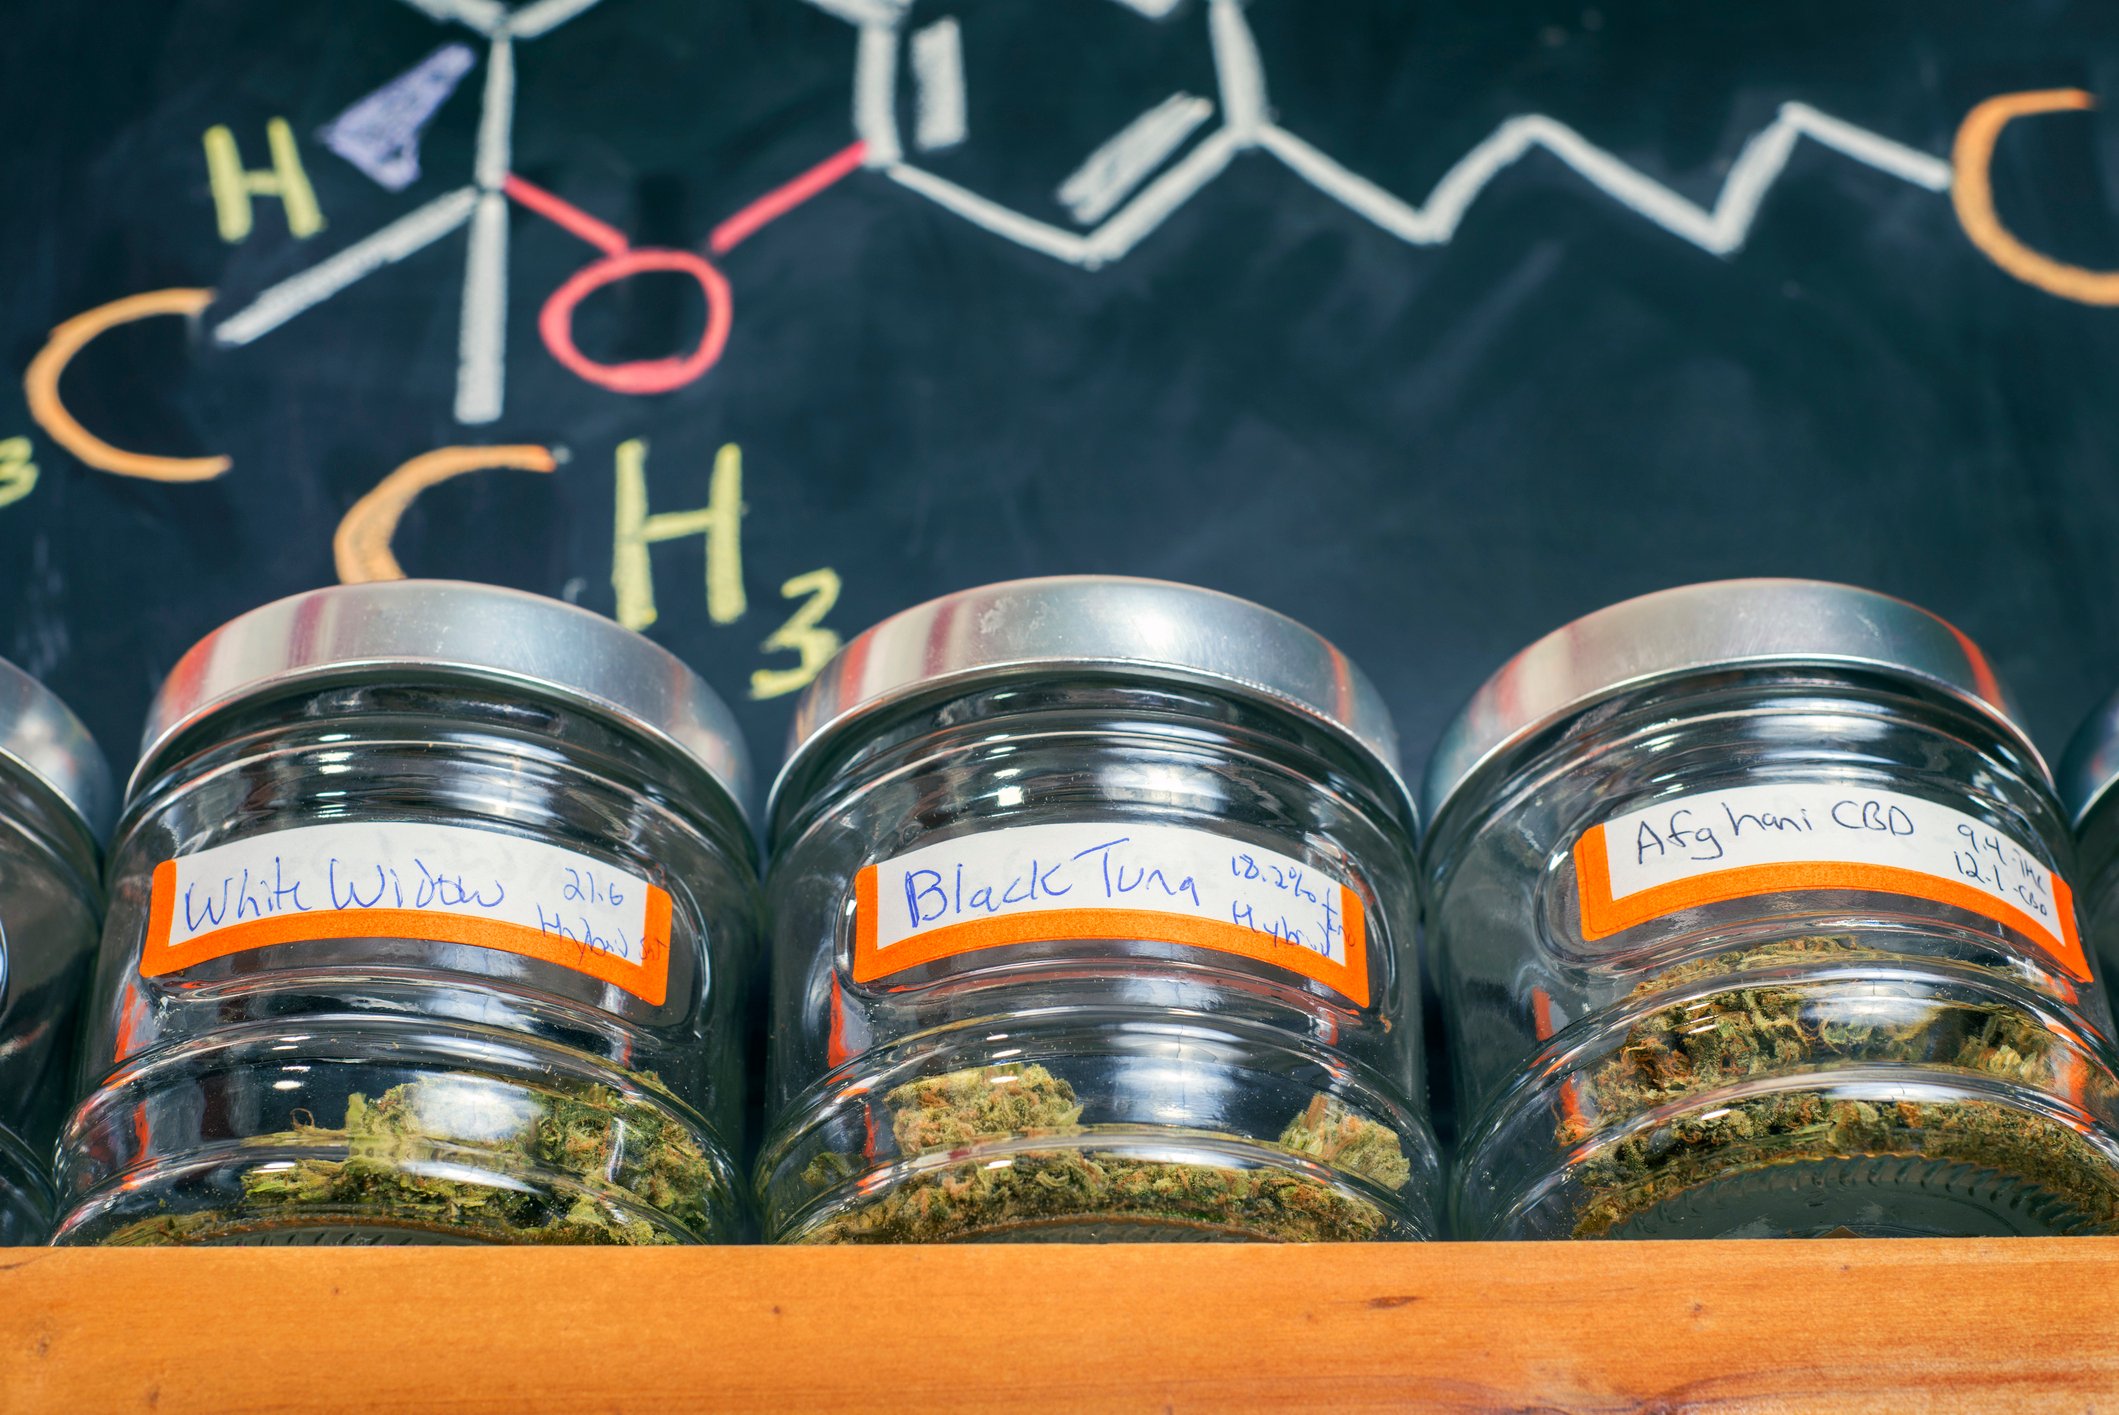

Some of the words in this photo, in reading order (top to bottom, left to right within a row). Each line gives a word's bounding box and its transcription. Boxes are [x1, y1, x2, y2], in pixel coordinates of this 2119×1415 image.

[203, 117, 326, 243] H
[1637, 802, 1813, 865] Afghani
[1831, 800, 1915, 836] CBD
[1957, 824, 2007, 867] 9.4
[185, 856, 312, 932] White
[563, 867, 624, 906] 21.6
[904, 859, 1073, 928] Black
[1071, 837, 1200, 906] Tuna
[1231, 853, 1317, 903] 18.2%
[1953, 850, 2004, 892] 12.1
